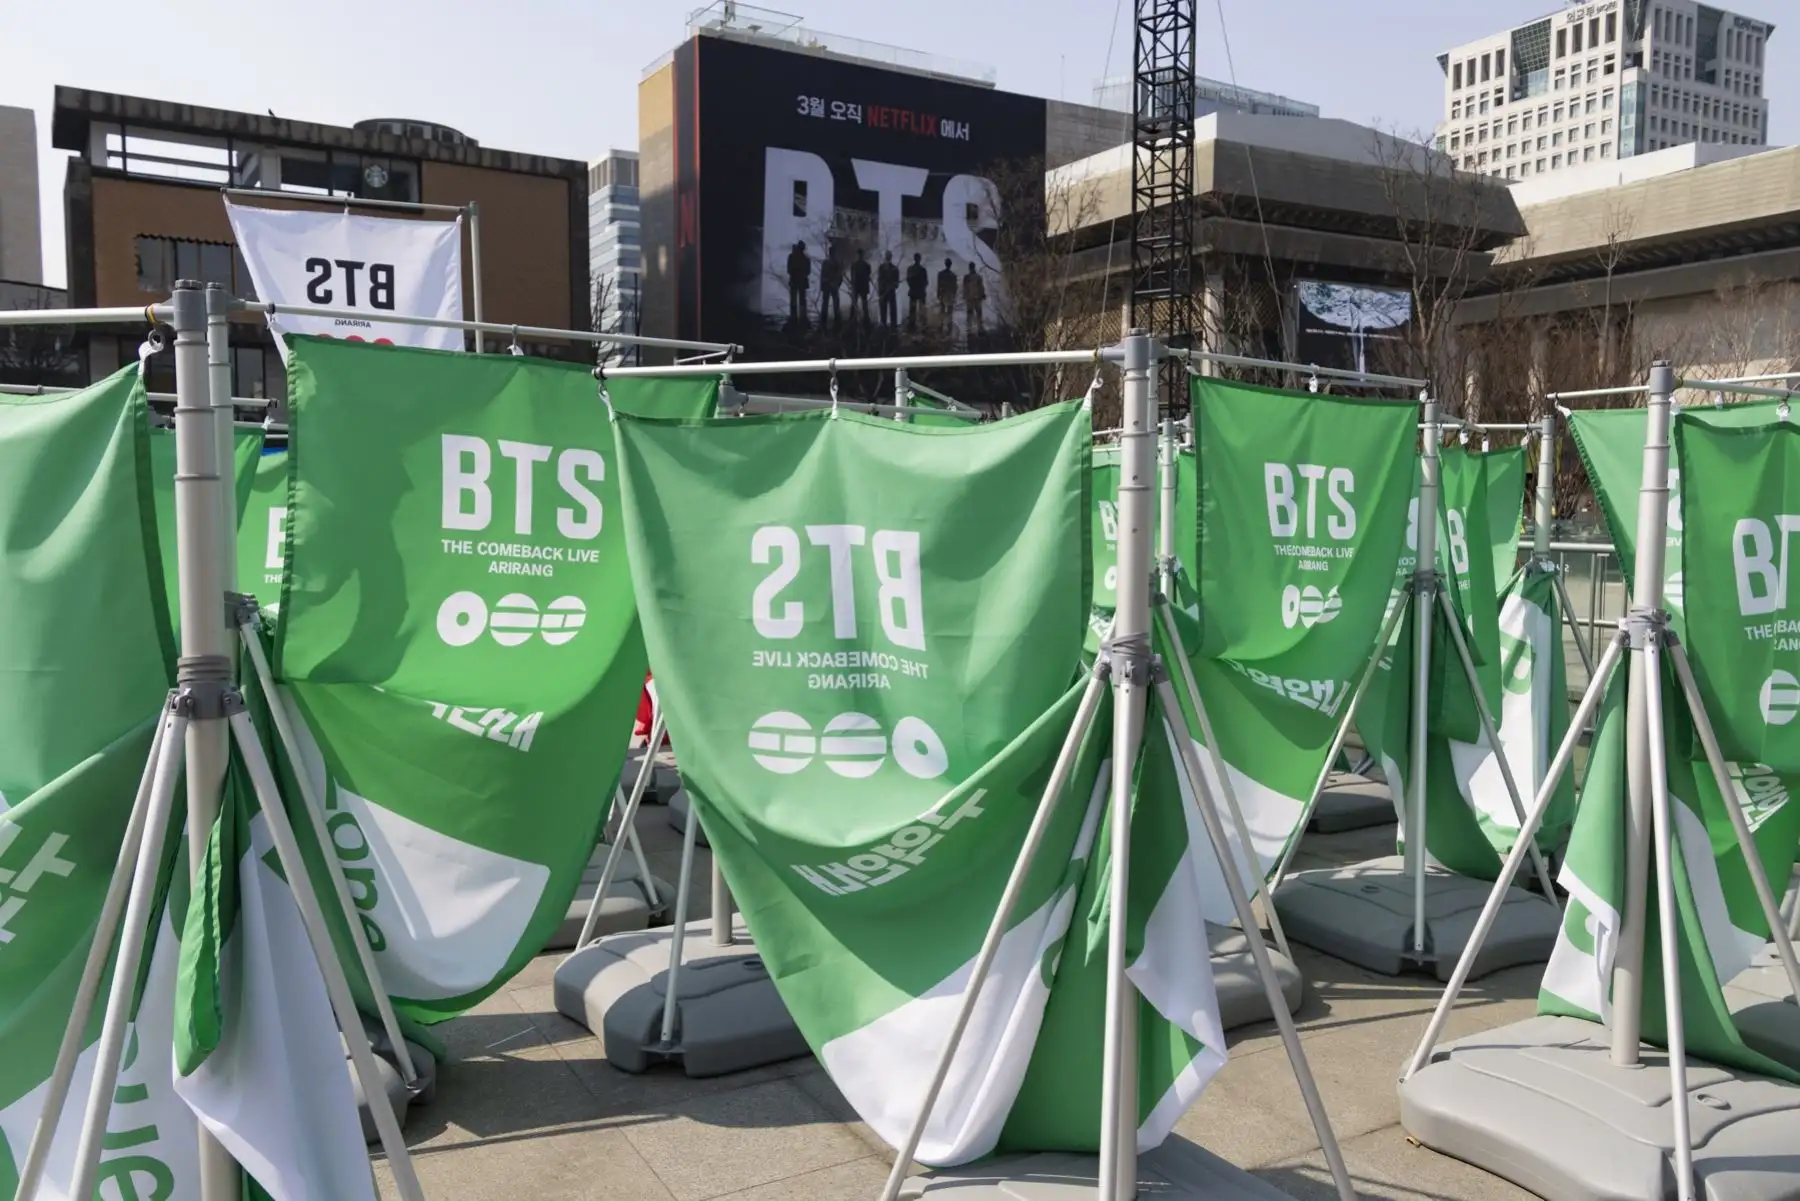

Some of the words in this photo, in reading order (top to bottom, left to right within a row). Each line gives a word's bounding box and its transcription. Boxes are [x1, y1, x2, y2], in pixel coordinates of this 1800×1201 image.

[797, 95, 825, 118] 3월
[830, 101, 862, 124] 오직
[867, 105, 938, 137] NETFLIX
[940, 119, 970, 141] 에서
[760, 146, 1003, 325] BTS
[441, 433, 605, 540] BTS
[1265, 463, 1357, 540] BTS
[441, 539, 473, 555] THE
[477, 542, 563, 561] COMEBACK
[567, 548, 600, 563] LIVE
[488, 560, 553, 577] ARIRANG
[1732, 515, 1800, 617] BT
